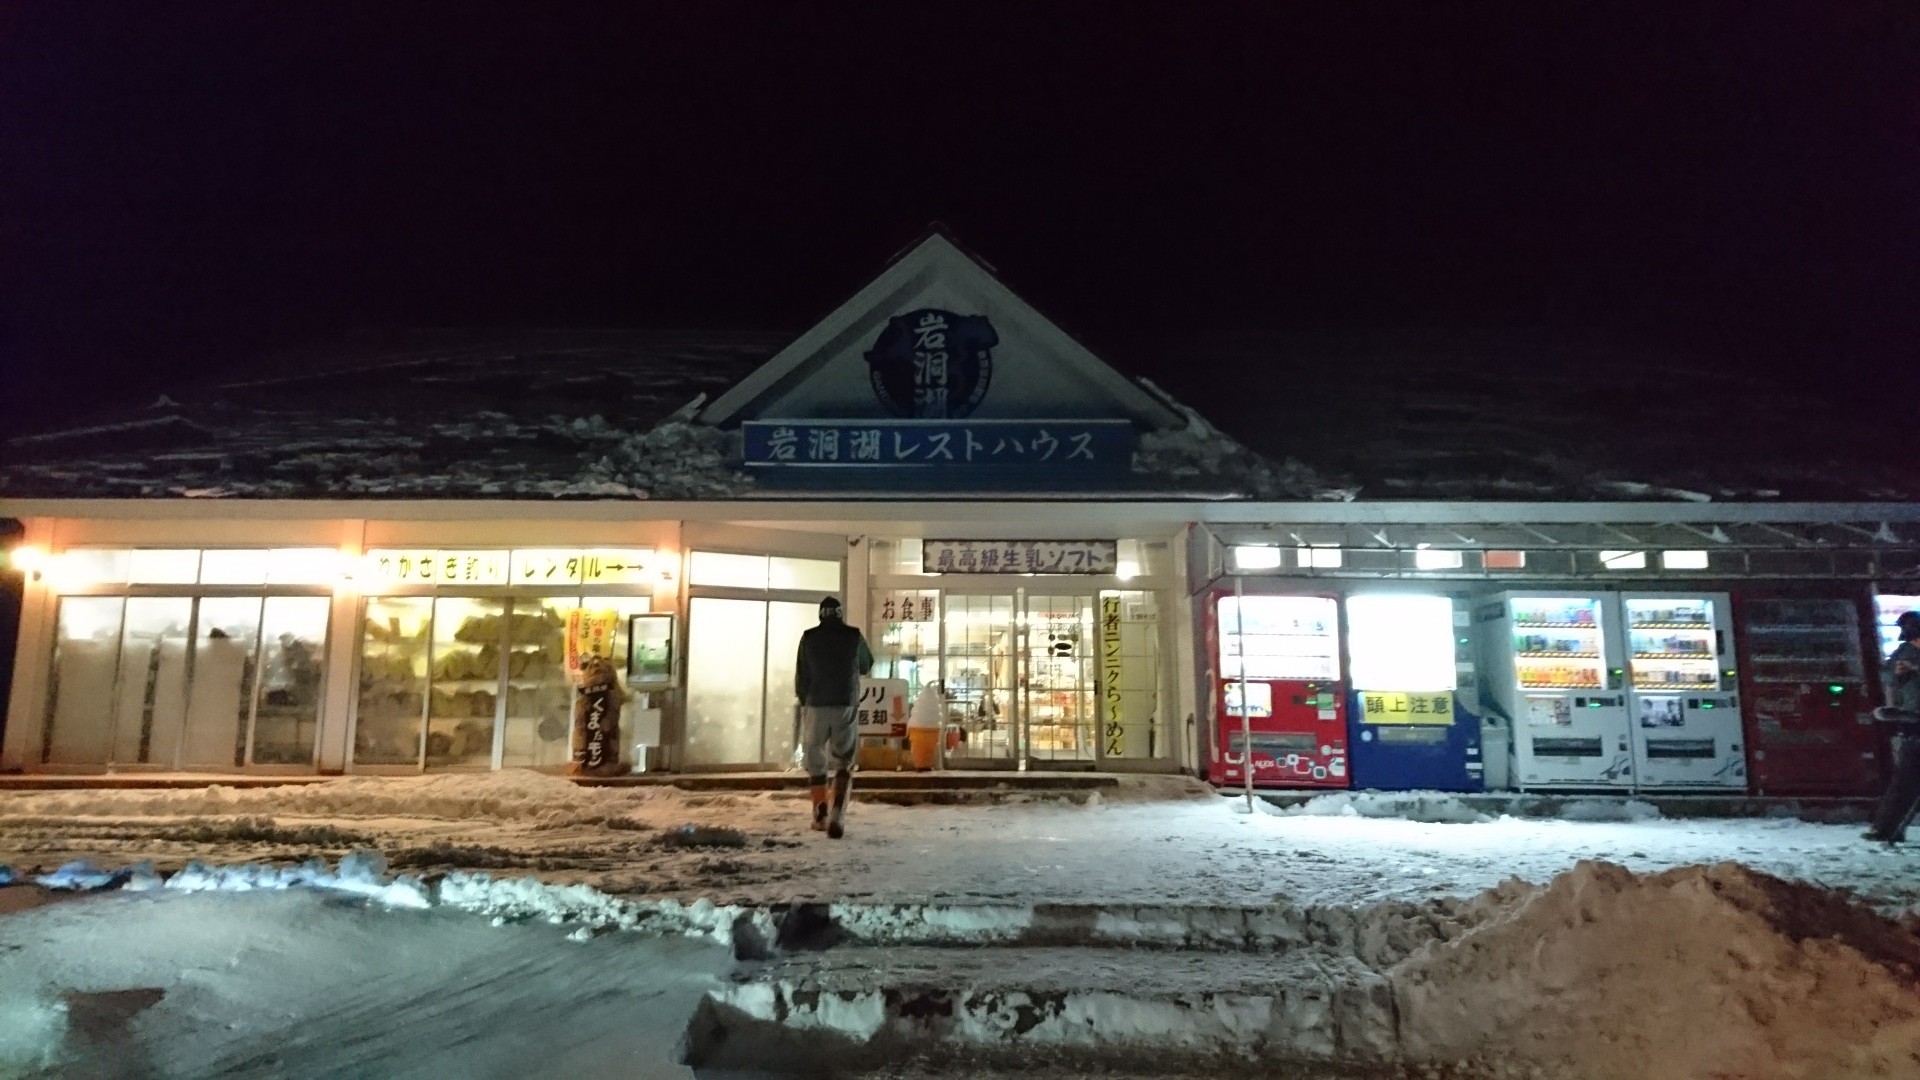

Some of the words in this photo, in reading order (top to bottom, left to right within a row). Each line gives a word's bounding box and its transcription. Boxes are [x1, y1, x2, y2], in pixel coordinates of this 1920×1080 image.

[768, 427, 1094, 461] 岩洞湖レストハウス
[526, 555, 602, 578] レンタル
[938, 548, 1103, 568] 最高級生乳ソフト
[882, 597, 934, 621] お食事
[1365, 695, 1450, 714] 頭上注意
